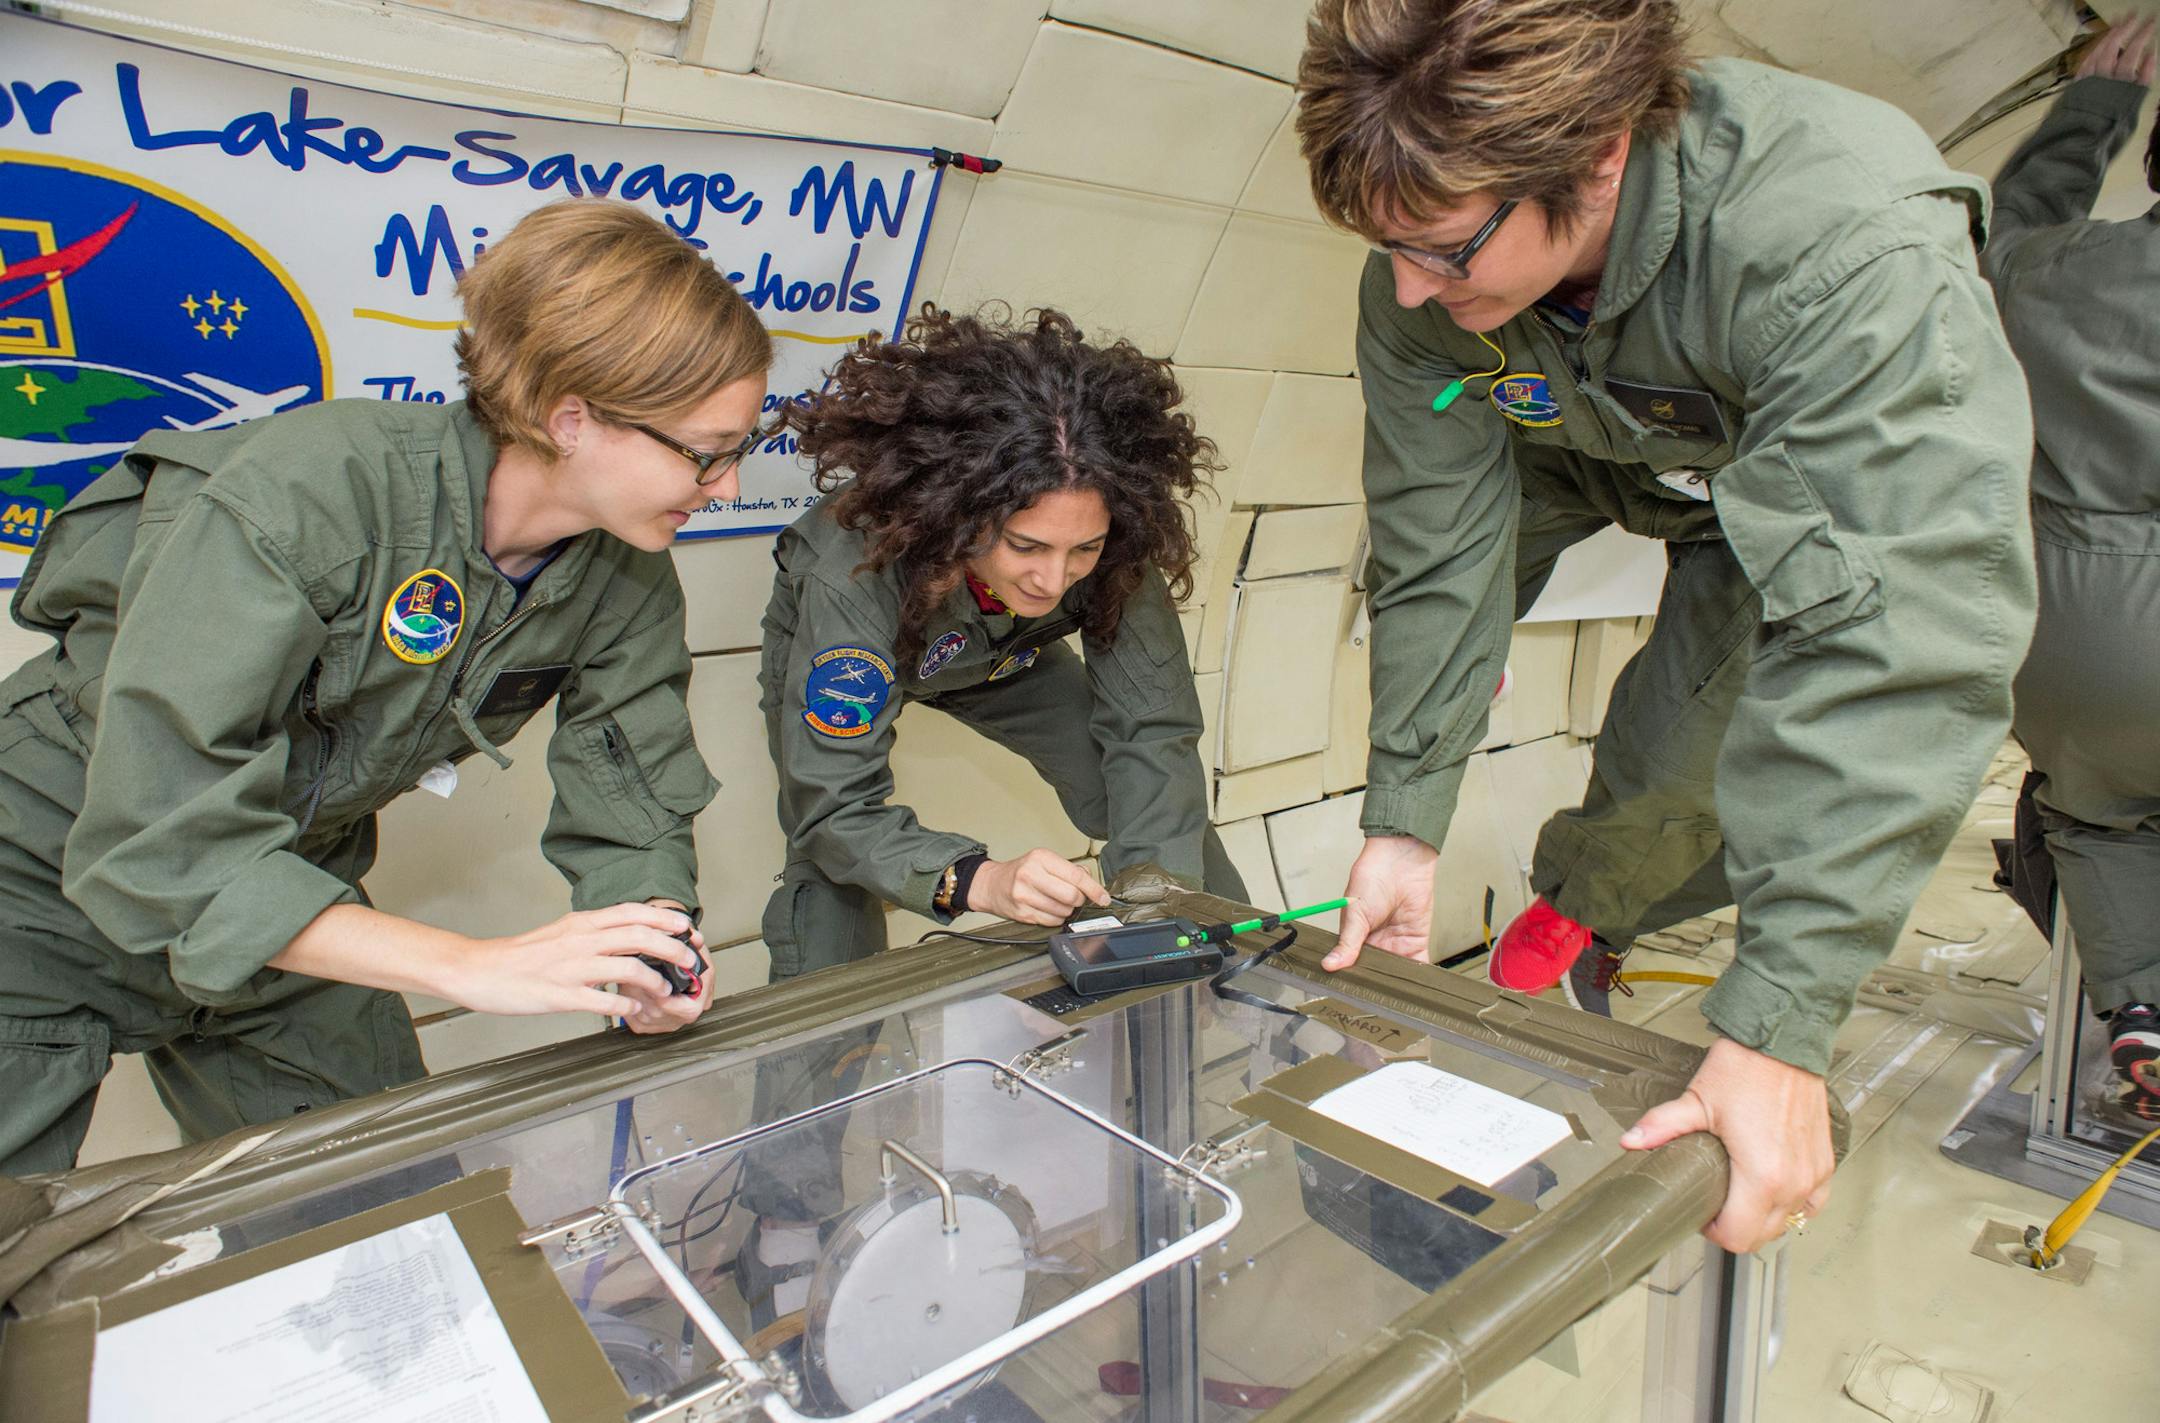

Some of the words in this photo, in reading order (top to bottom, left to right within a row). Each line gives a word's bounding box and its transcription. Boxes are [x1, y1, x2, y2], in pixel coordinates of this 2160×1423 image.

[790, 161, 916, 240] MN
[732, 496, 778, 513] Houston,
[780, 497, 799, 509] TX
